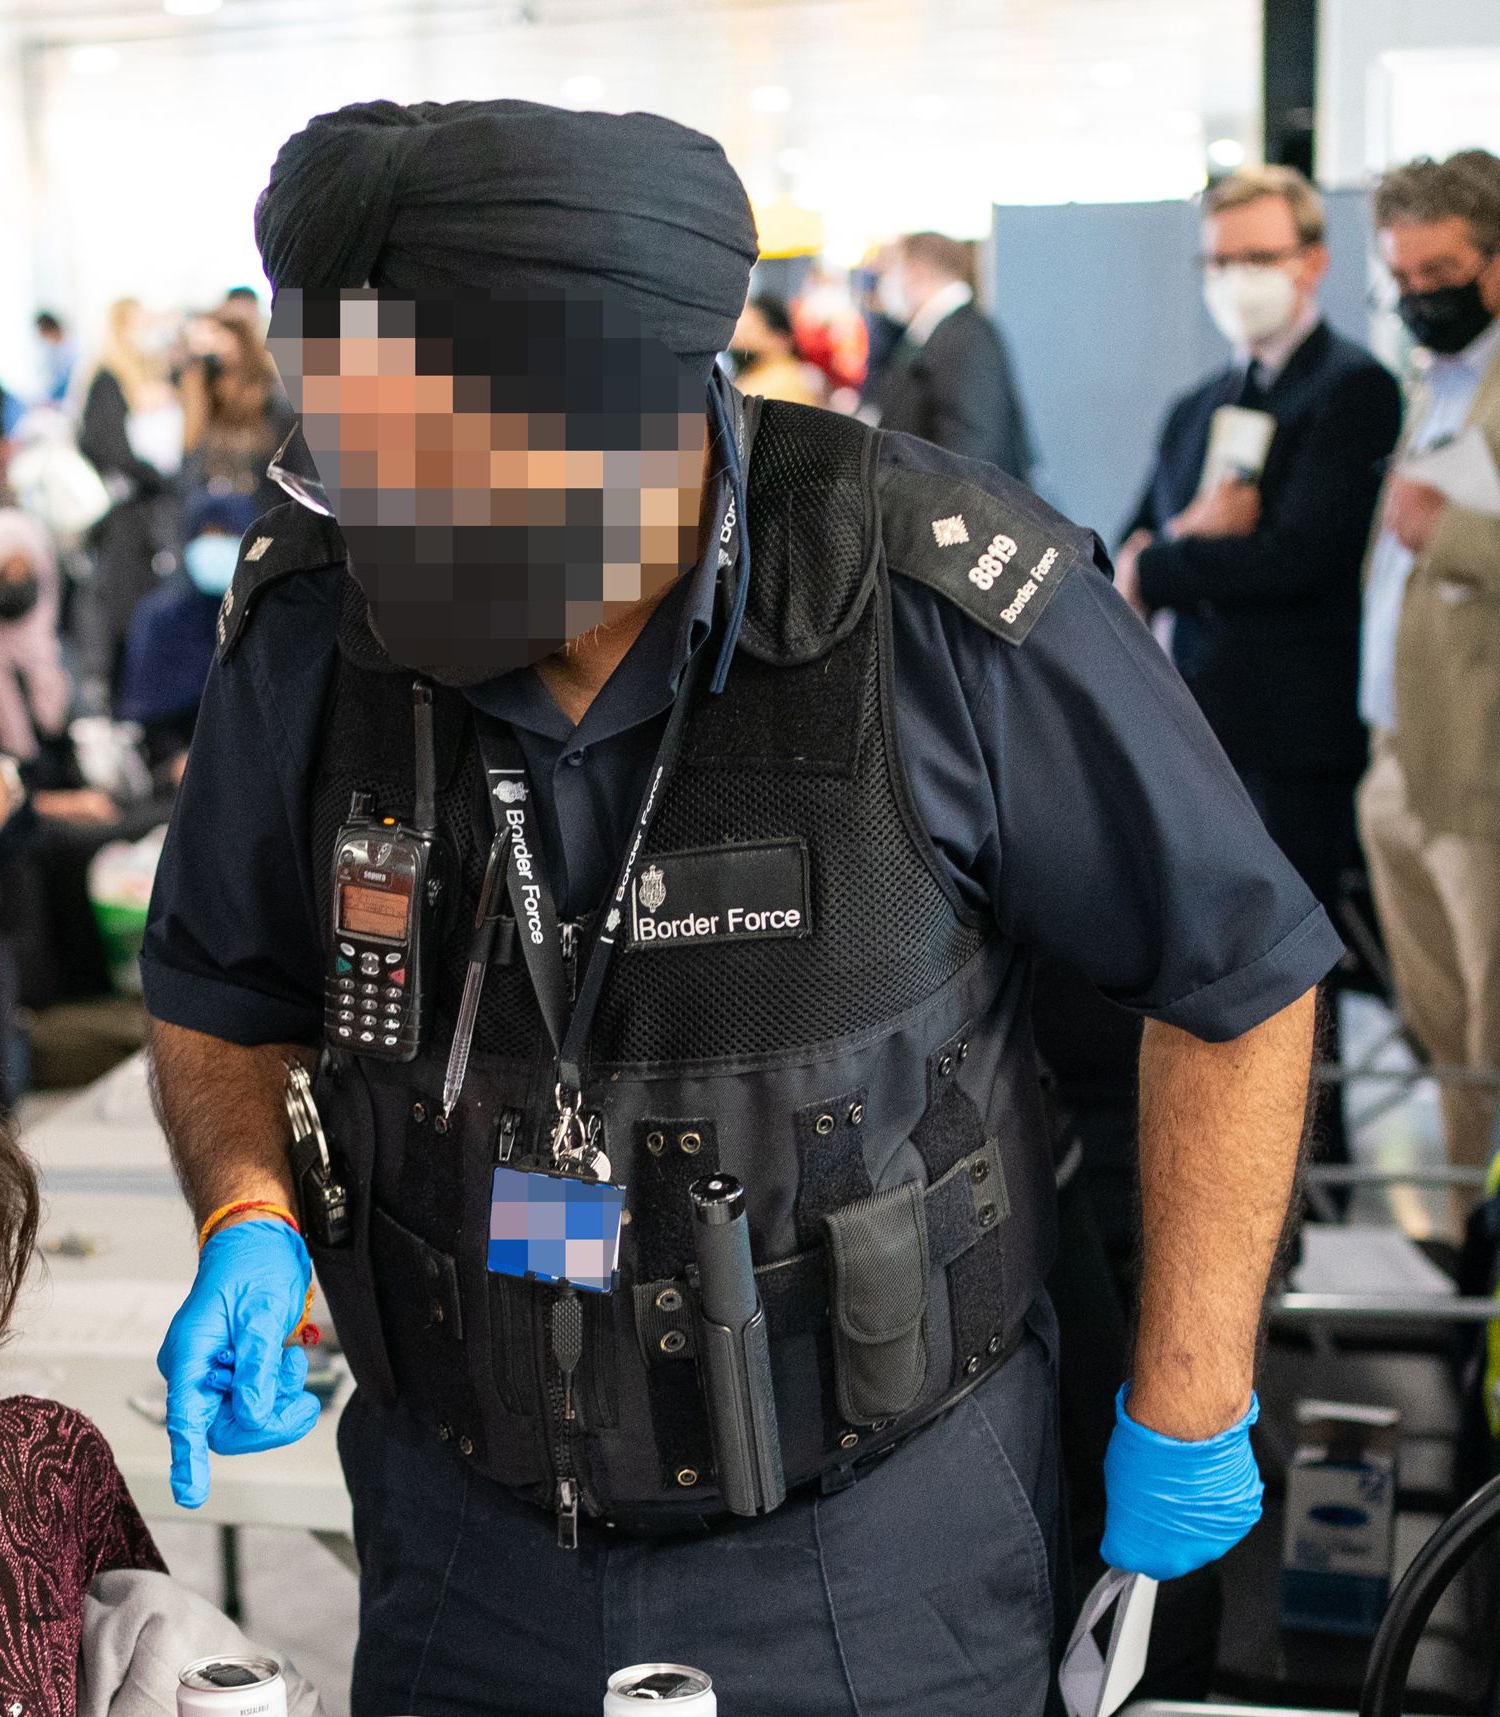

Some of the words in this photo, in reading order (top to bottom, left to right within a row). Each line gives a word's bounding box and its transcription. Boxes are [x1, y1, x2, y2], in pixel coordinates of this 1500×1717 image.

[968, 534, 1018, 591] 8819
[1000, 576, 1039, 625] Border
[1030, 547, 1059, 583] Force
[616, 829, 642, 902] Border
[641, 765, 663, 825] Force
[505, 809, 534, 881] Border
[521, 884, 544, 945] Force
[638, 913, 719, 941] Border
[728, 908, 801, 933] Force
